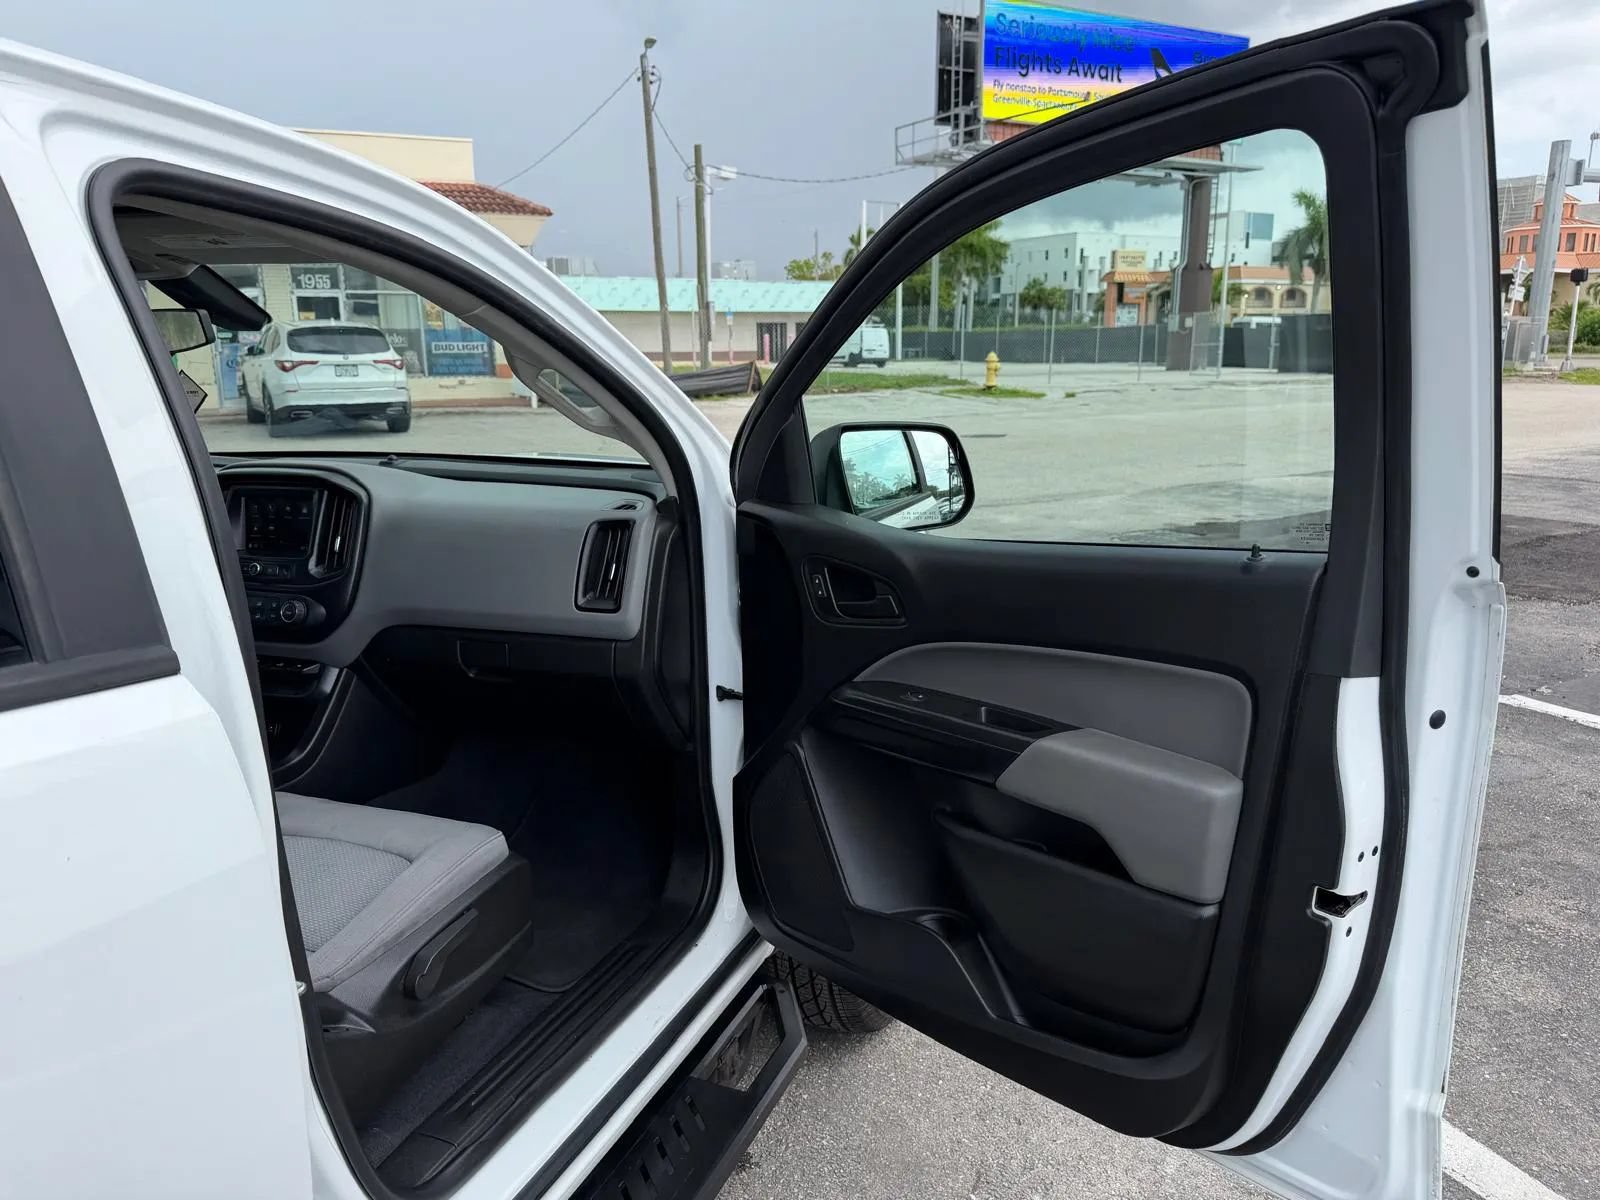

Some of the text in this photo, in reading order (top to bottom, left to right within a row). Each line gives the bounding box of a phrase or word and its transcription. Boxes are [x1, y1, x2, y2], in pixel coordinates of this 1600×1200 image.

[996, 13, 1087, 51] Seriously
[994, 46, 1123, 83] Flights Await
[993, 79, 1004, 91] Fly
[1005, 82, 1037, 95] nonstop
[1038, 85, 1047, 95] to
[297, 273, 332, 289] 1955
[433, 343, 486, 352] BUD LIGHT
